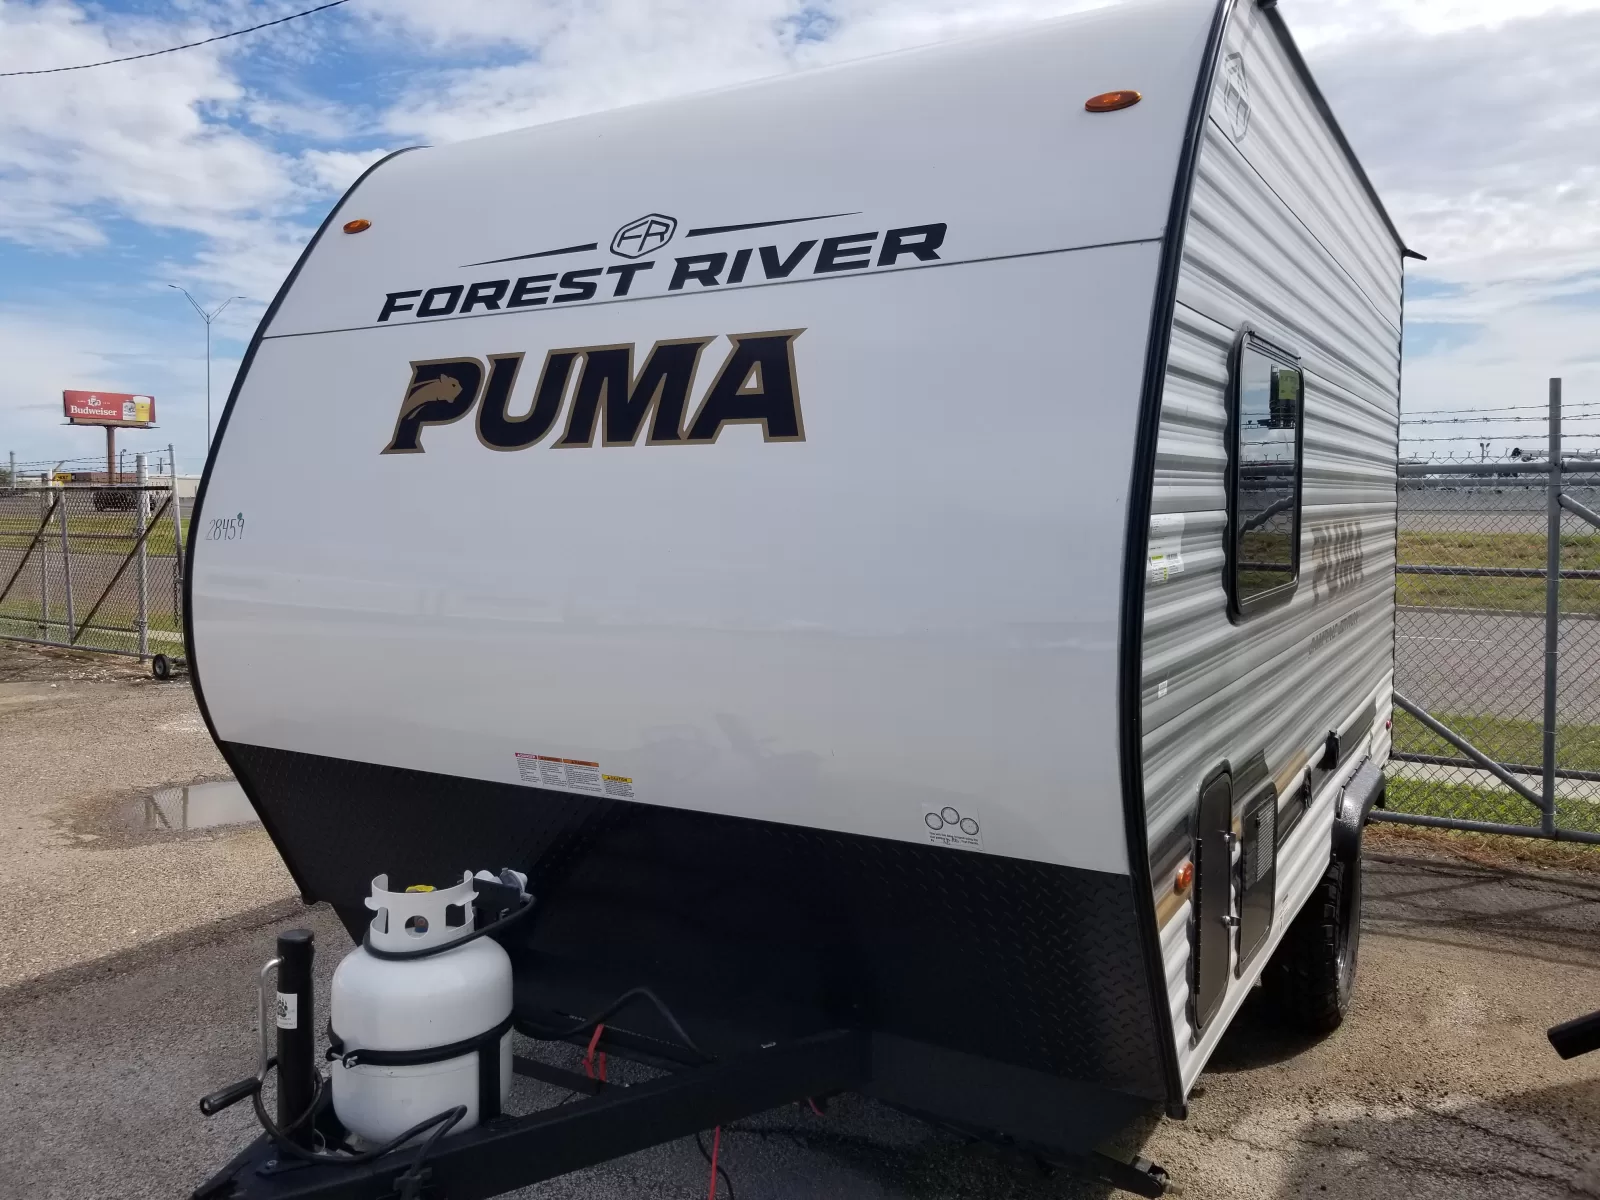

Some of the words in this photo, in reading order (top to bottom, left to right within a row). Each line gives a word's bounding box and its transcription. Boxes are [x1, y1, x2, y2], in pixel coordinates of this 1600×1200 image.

[377, 261, 655, 322] FOREST
[667, 222, 948, 292] RIVER
[70, 405, 117, 416] Budweiser
[379, 327, 807, 455] PUMA
[205, 518, 245, 541] 28459
[1311, 521, 1364, 604] PUMA
